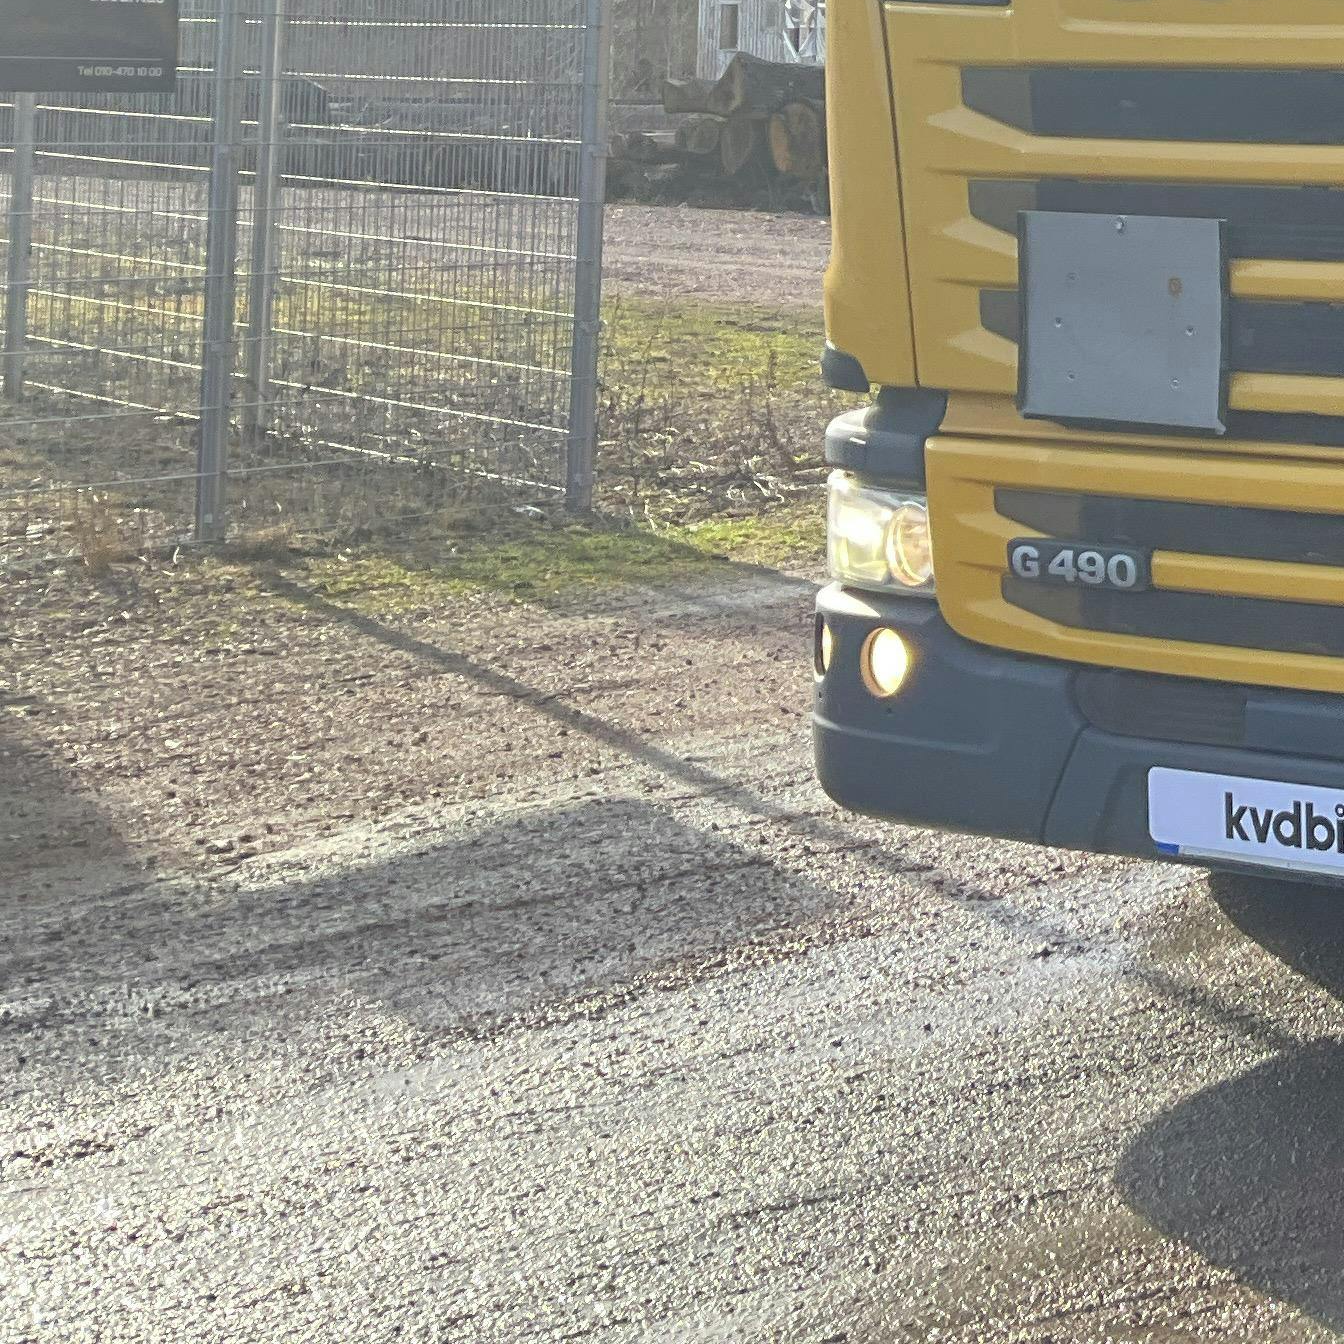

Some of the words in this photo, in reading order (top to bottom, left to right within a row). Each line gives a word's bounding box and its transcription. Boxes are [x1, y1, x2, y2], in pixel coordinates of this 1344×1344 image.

[77, 65, 94, 76] Tel
[137, 67, 147, 77] 10
[148, 67, 162, 77] 00
[1012, 545, 1040, 578] G
[1048, 549, 1136, 588] 490
